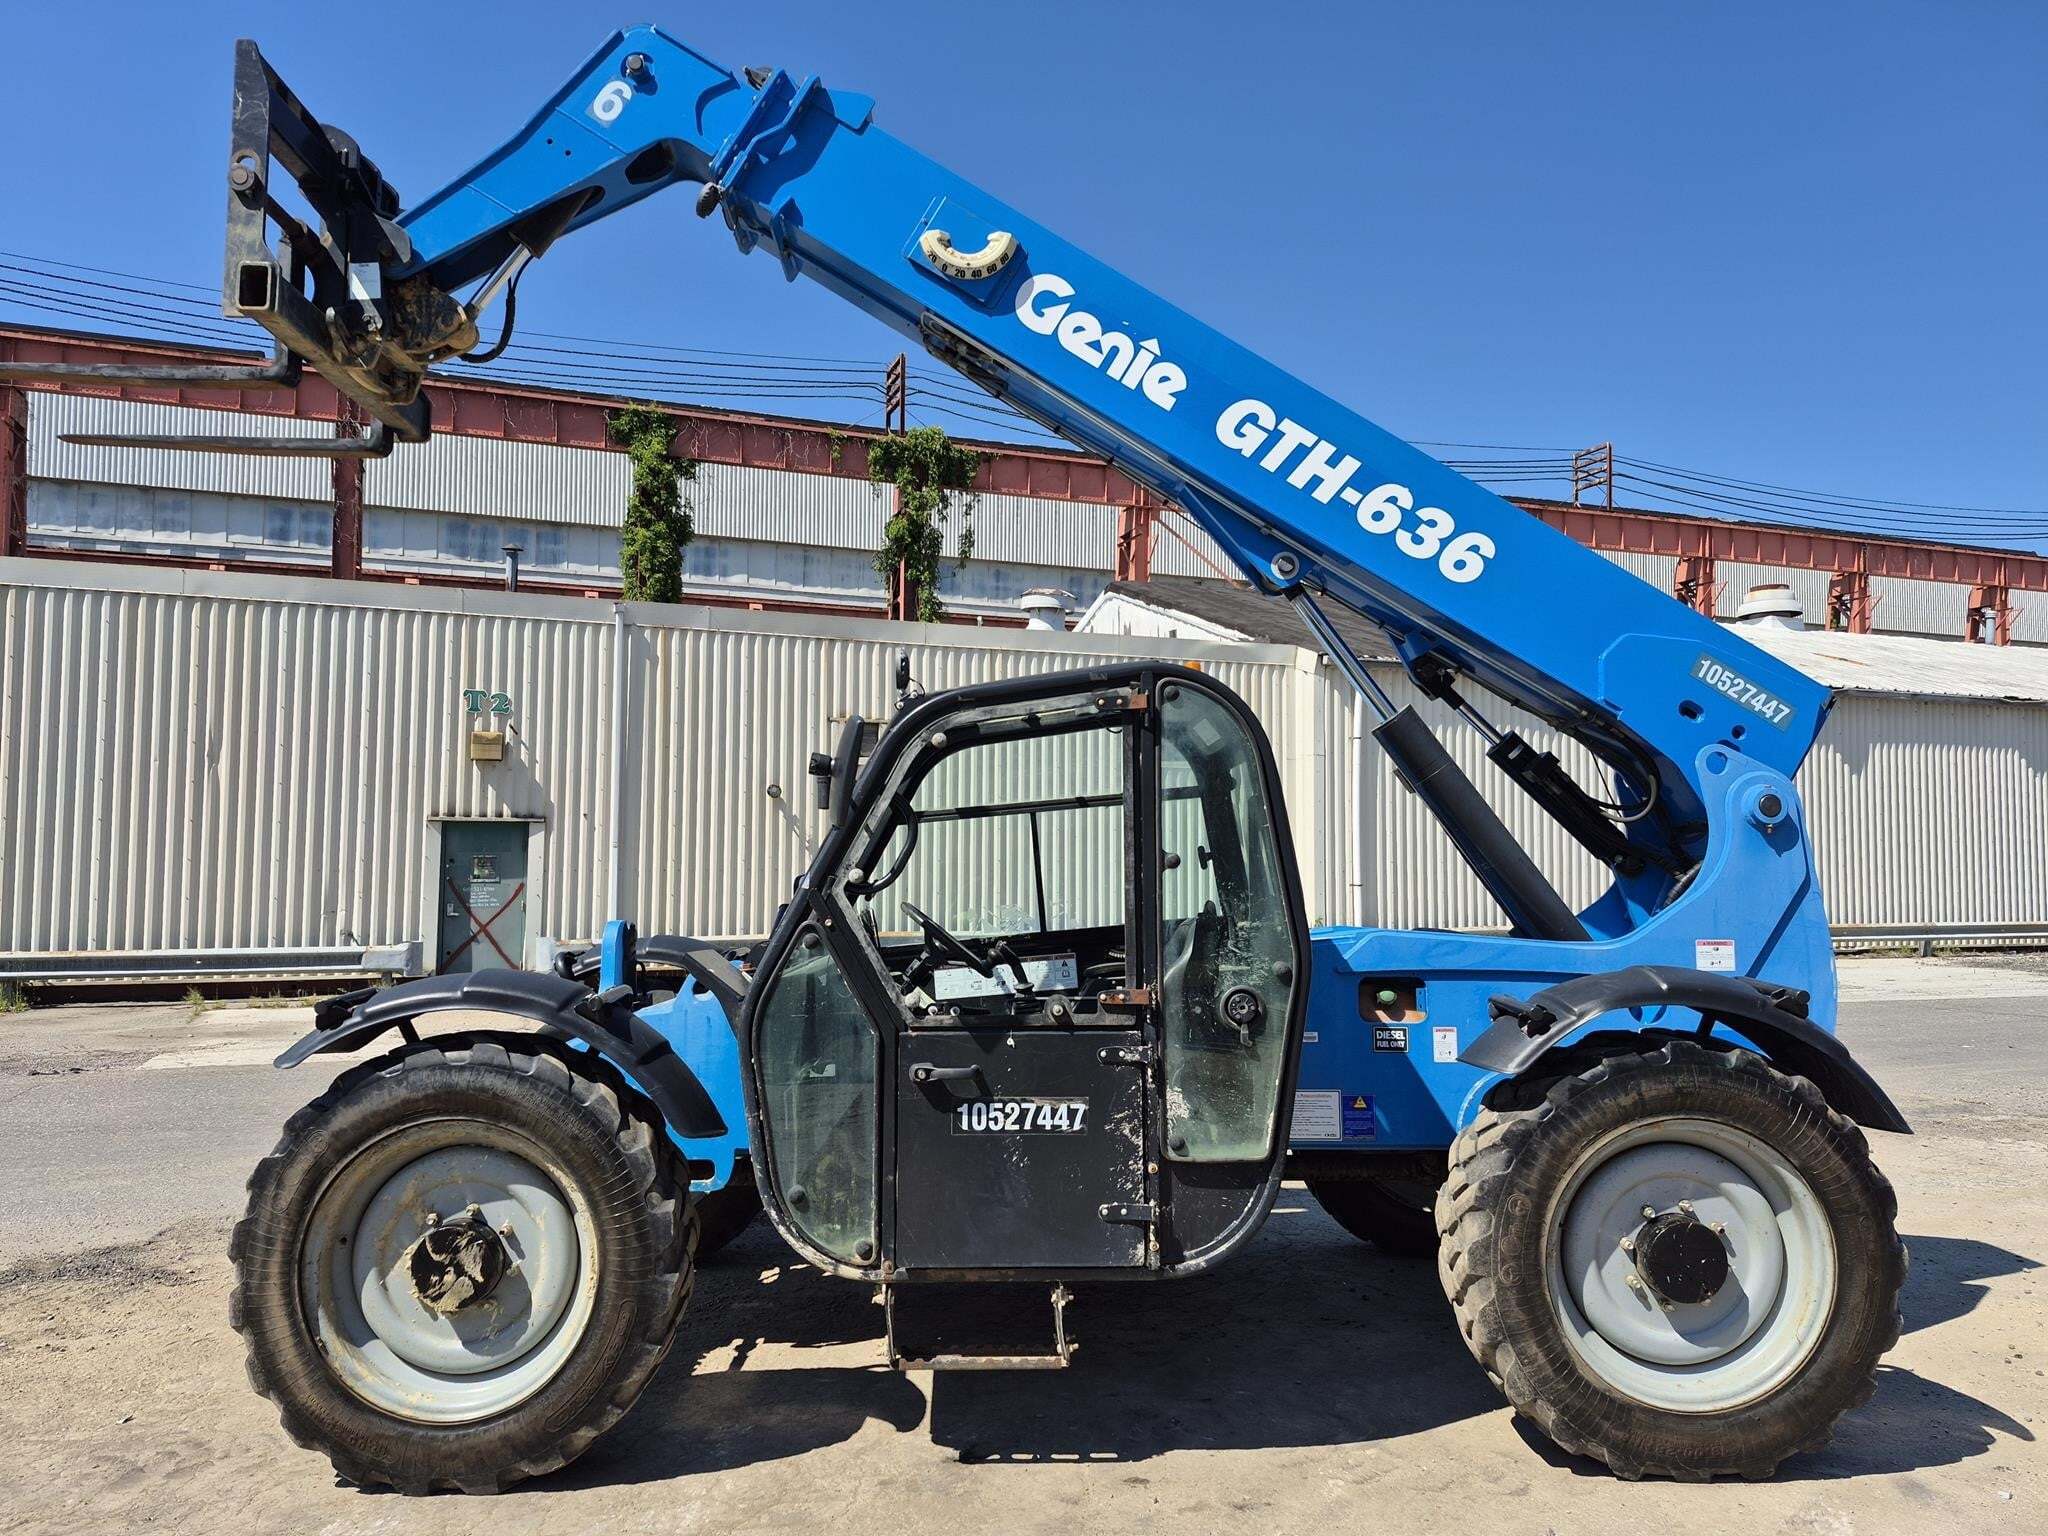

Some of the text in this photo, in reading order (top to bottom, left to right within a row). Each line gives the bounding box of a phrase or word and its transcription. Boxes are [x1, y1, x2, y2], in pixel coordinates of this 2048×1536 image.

[593, 80, 632, 121] 6
[941, 263, 949, 273] 0
[954, 268, 966, 278] 20
[971, 269, 983, 278] 40
[986, 263, 998, 274] 60
[1000, 252, 1010, 265] 80
[1015, 273, 1496, 584] Genie GTH-636
[1698, 659, 1791, 724] 10527447
[1376, 1030, 1406, 1040] DIESEL
[957, 1102, 1087, 1131] 10527447
